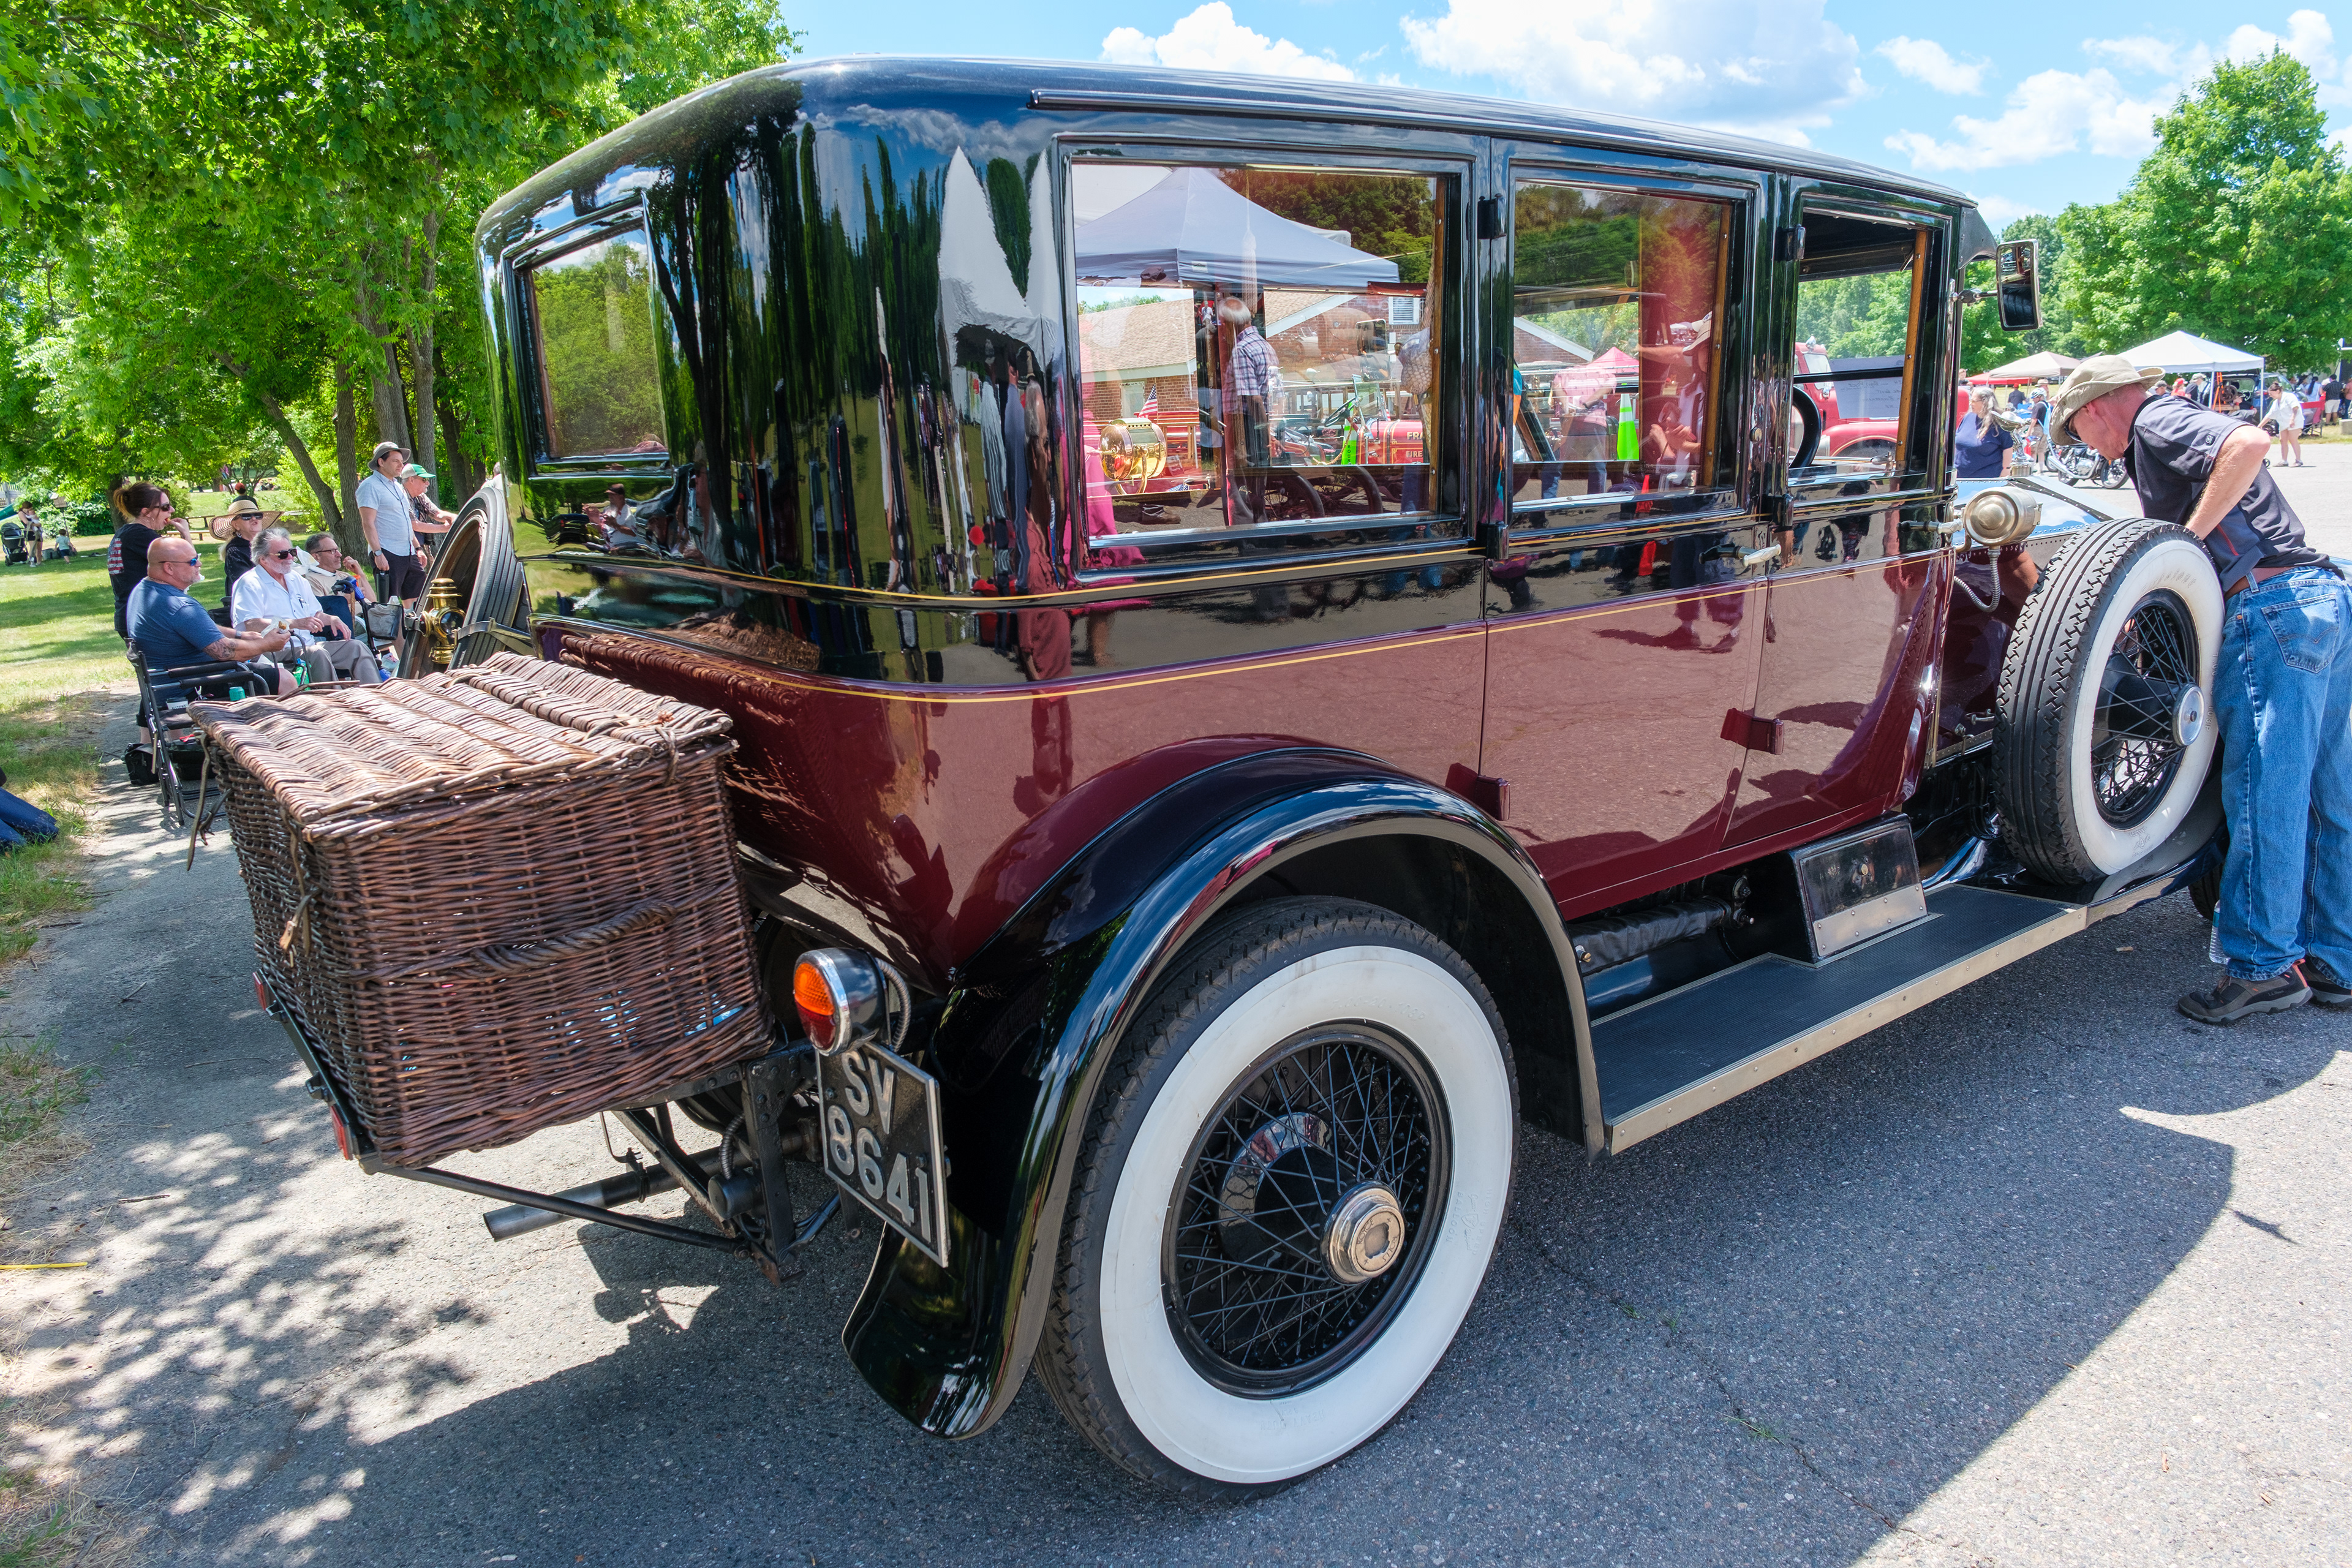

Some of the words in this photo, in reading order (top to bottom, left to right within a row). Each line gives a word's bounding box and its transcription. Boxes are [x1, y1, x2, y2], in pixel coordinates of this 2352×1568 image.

[842, 1050, 896, 1134] SV
[827, 1104, 932, 1243] 8641
[1356, 1218, 1374, 1245] ROYCE
[1446, 1191, 1464, 1243] BALLOON
[1382, 1234, 1399, 1262] ROLLS
